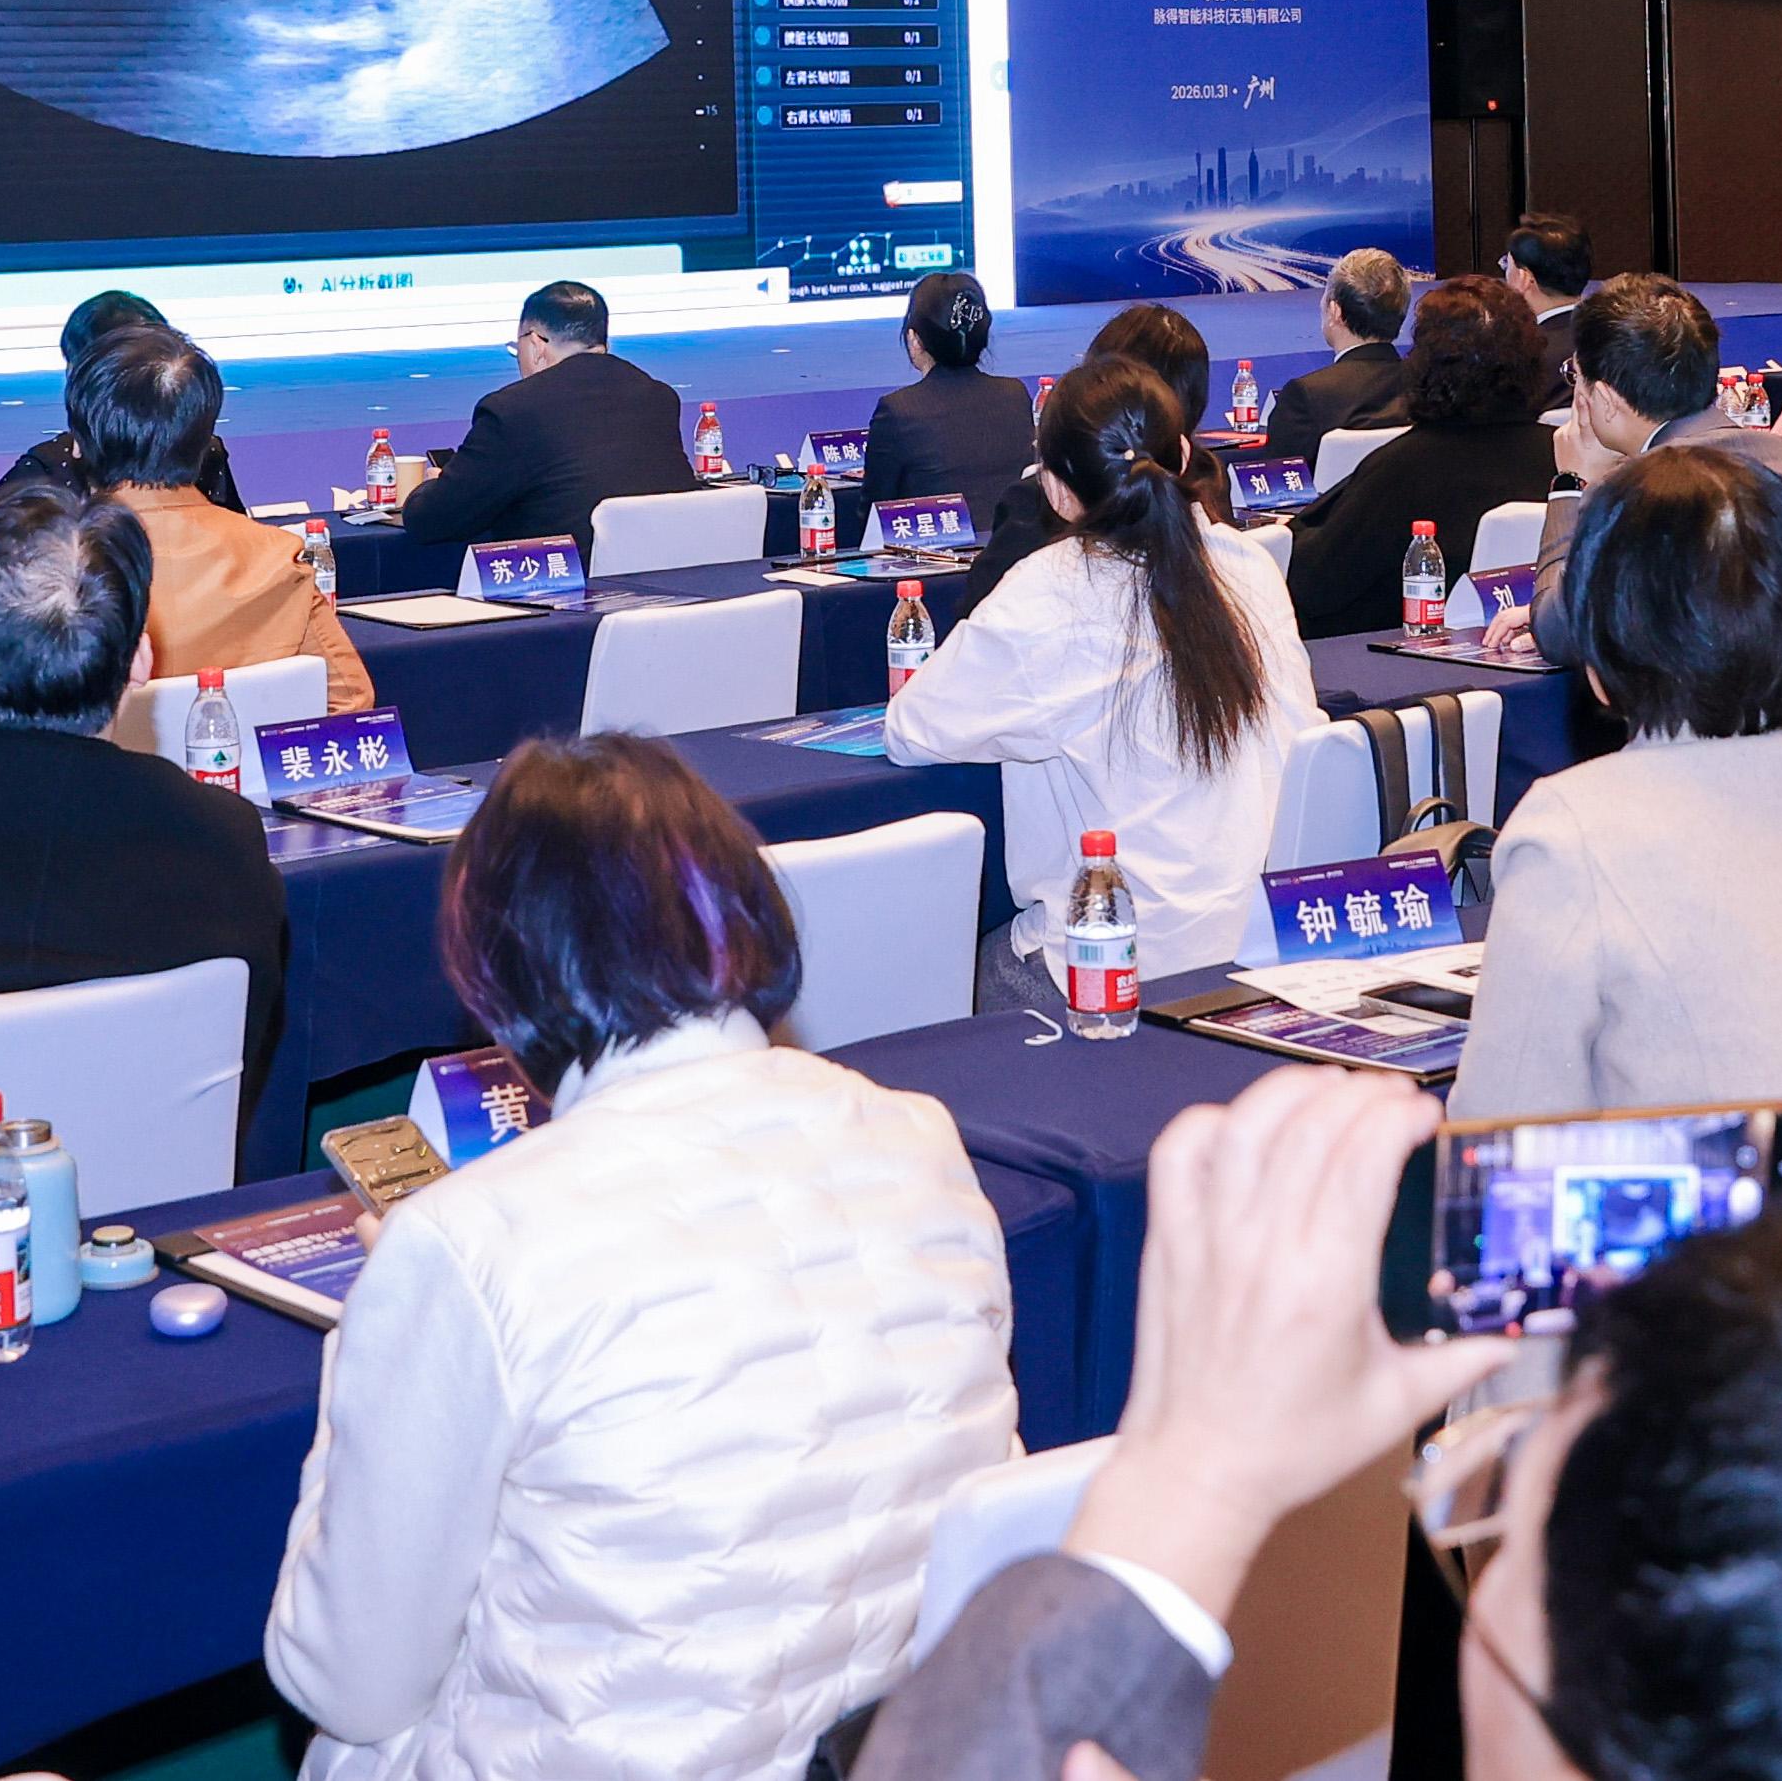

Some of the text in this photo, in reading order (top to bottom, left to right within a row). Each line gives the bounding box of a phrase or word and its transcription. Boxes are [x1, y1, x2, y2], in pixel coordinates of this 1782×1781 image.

[1154, 7, 1302, 25] 脉得智能科技(无锡)有限公司
[904, 31, 920, 44] 0/1
[905, 69, 921, 83] 0/1
[1171, 82, 1228, 100] 2026.01.31
[705, 106, 718, 117] 15
[906, 108, 922, 122] 0/1
[892, 510, 961, 539] 宋星慧
[490, 553, 570, 584] 苏少晨
[280, 735, 389, 781] 裴永彬
[1296, 882, 1433, 945] 钟毓瑜
[480, 1083, 530, 1143] 黄
